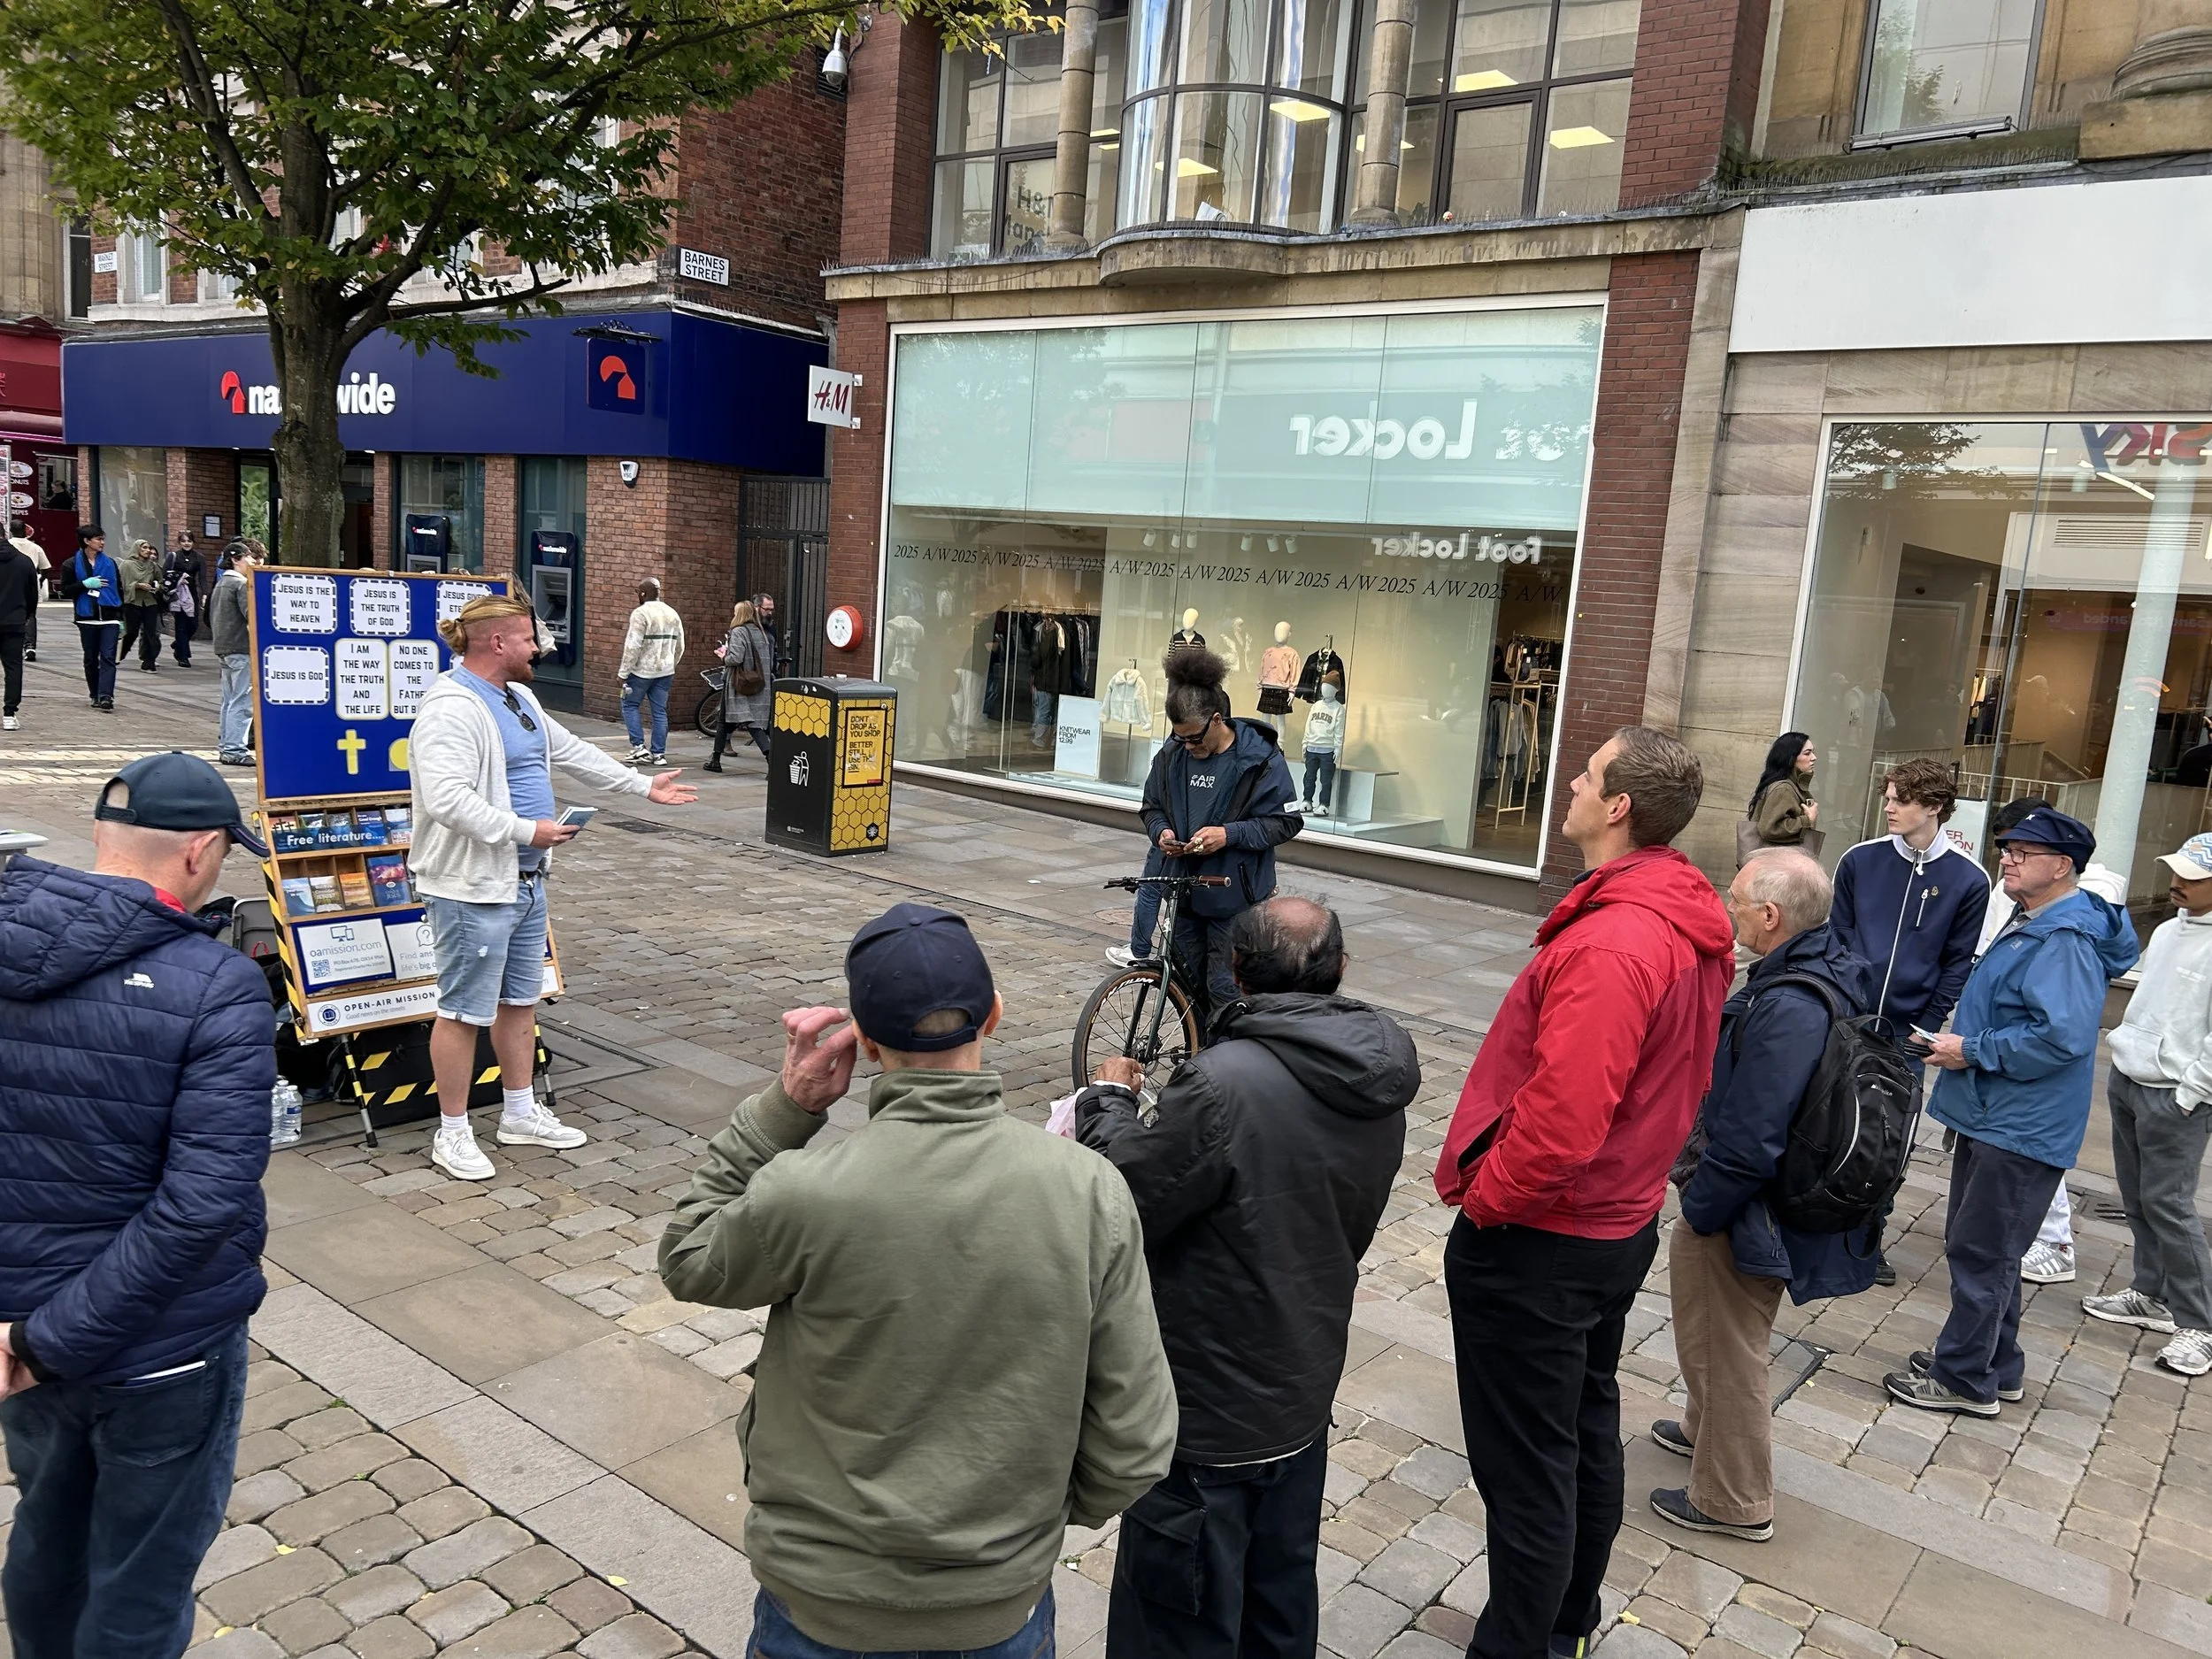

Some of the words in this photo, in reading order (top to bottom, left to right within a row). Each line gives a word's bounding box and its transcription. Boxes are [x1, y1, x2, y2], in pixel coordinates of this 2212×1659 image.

[685, 251, 725, 271] BARNES
[686, 264, 723, 282] STREET
[814, 380, 849, 415] H&M
[894, 544, 919, 559] 2025
[923, 546, 950, 562] A/W
[951, 549, 978, 564] 2025
[981, 550, 1012, 566] A/W
[1011, 553, 1040, 568] 2025
[1043, 556, 1074, 571] A/W
[1078, 557, 1105, 572] 2025
[1110, 559, 1143, 576] A/W
[1144, 561, 1175, 578] 2025
[1180, 564, 1217, 581] A/W
[1217, 566, 1250, 583] 2025
[1256, 568, 1294, 586] A/W
[1294, 572, 1331, 588] 2025
[1336, 573, 1378, 592] A/W
[1378, 577, 1417, 594] 2025
[1422, 579, 1466, 598] A/W
[1467, 582, 1508, 601] 2025
[1515, 584, 1563, 603] A/W
[315, 587, 330, 595] THE
[389, 590, 396, 599] IS
[290, 600, 308, 609] WAY
[377, 604, 400, 613] TRUTH
[290, 614, 320, 623] HEAVEN
[350, 644, 353, 653] I
[356, 645, 370, 654] AM
[412, 646, 428, 656] ONE
[343, 659, 359, 669] THE
[362, 660, 380, 669] WAY
[394, 661, 421, 670] COMES
[424, 661, 434, 670] TO
[340, 674, 356, 684] THE
[358, 675, 384, 684] TRUTH
[407, 676, 422, 685] THE
[353, 690, 370, 699] AND
[399, 689, 427, 699] FATHE
[345, 705, 361, 714] THE
[363, 705, 380, 714] LIFE
[1311, 712, 1333, 724] PARIS
[1060, 725, 1091, 735] KNITWEAR
[1190, 780, 1214, 788] MAX
[287, 834, 314, 846] Free
[1947, 830, 1962, 840] ER
[1955, 841, 1973, 850] ON
[310, 941, 382, 957] oamission.com
[419, 962, 431, 971] big
[344, 998, 392, 1012] OPEN-AIR
[396, 992, 435, 1003] MISSION
